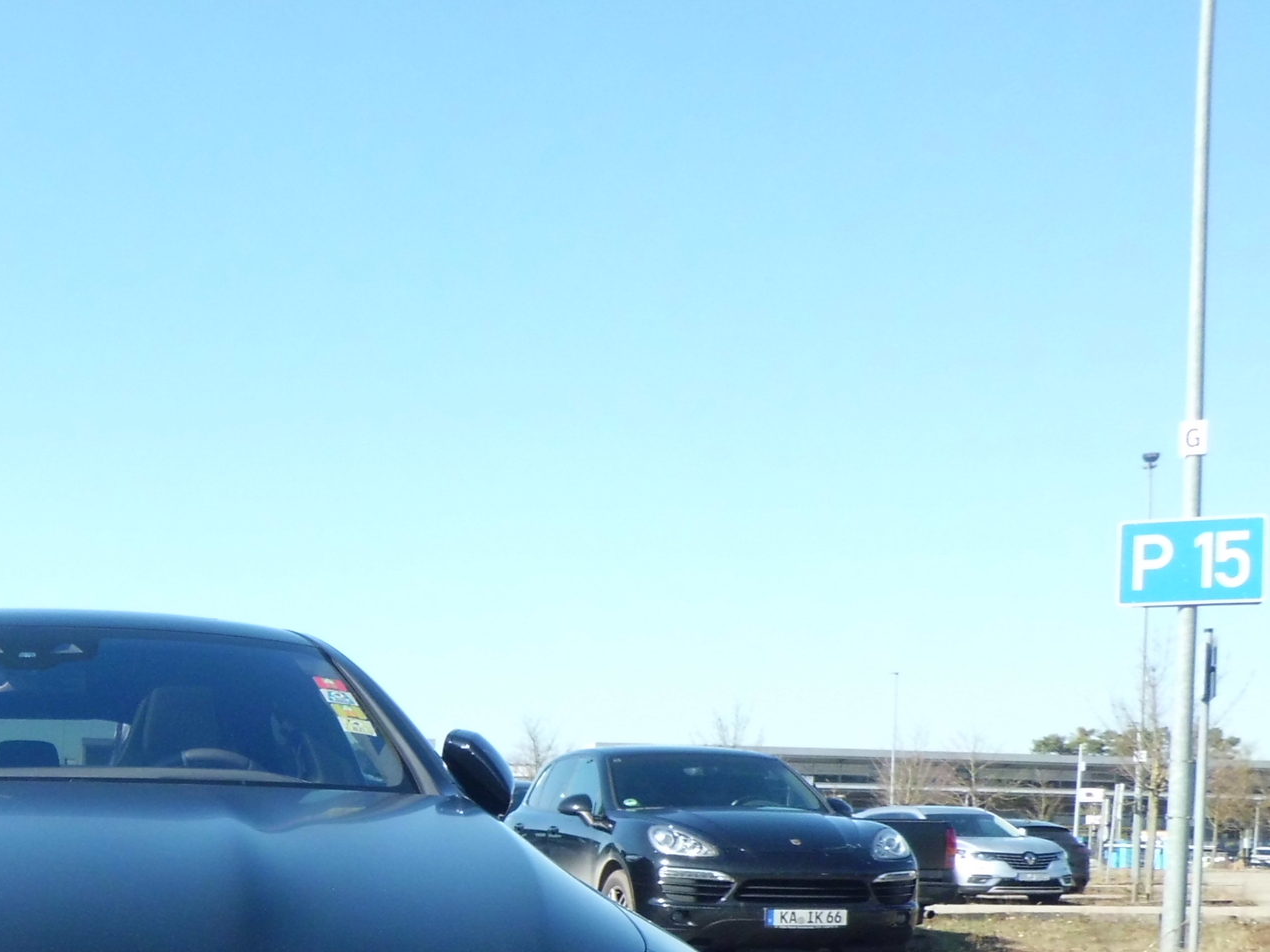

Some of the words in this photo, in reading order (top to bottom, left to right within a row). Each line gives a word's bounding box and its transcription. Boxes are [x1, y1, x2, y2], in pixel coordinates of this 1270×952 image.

[1186, 428, 1200, 447] G
[1132, 534, 1174, 591] P
[1194, 530, 1250, 588] 15
[779, 911, 797, 924] KA
[806, 911, 823, 924] IK
[826, 911, 842, 924] 66
